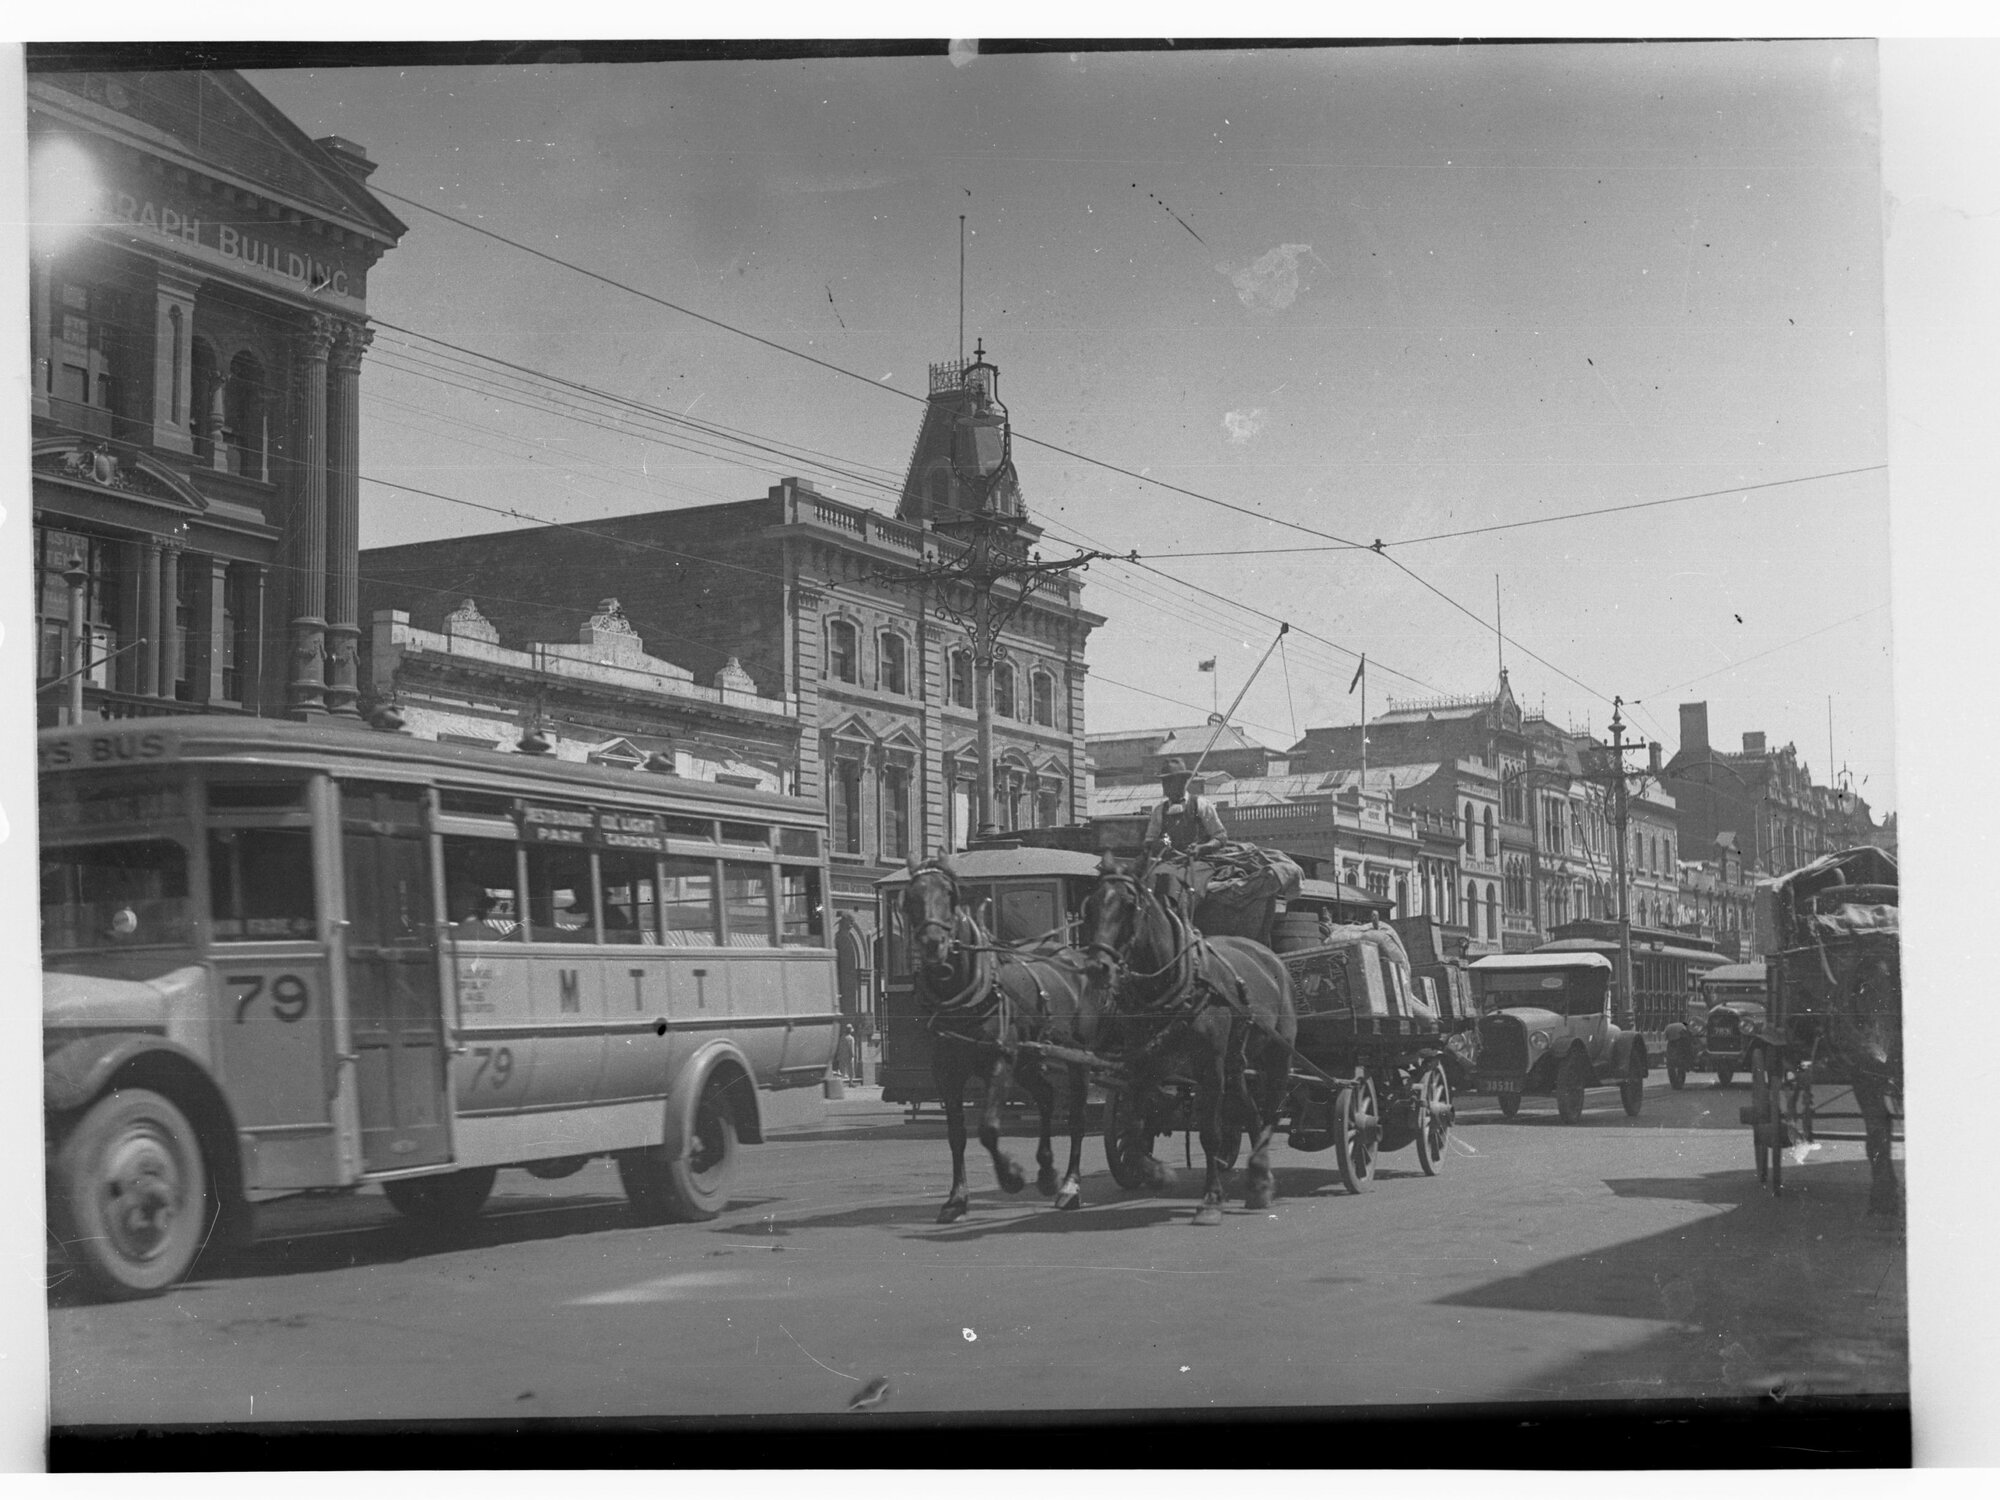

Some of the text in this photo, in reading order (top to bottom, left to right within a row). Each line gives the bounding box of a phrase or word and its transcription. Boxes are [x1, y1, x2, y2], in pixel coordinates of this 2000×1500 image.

[218, 224, 349, 298] BUILDING
[92, 734, 163, 761] BUS
[538, 827, 584, 843] PARK
[226, 973, 309, 1025] 79
[471, 1046, 514, 1091] 79
